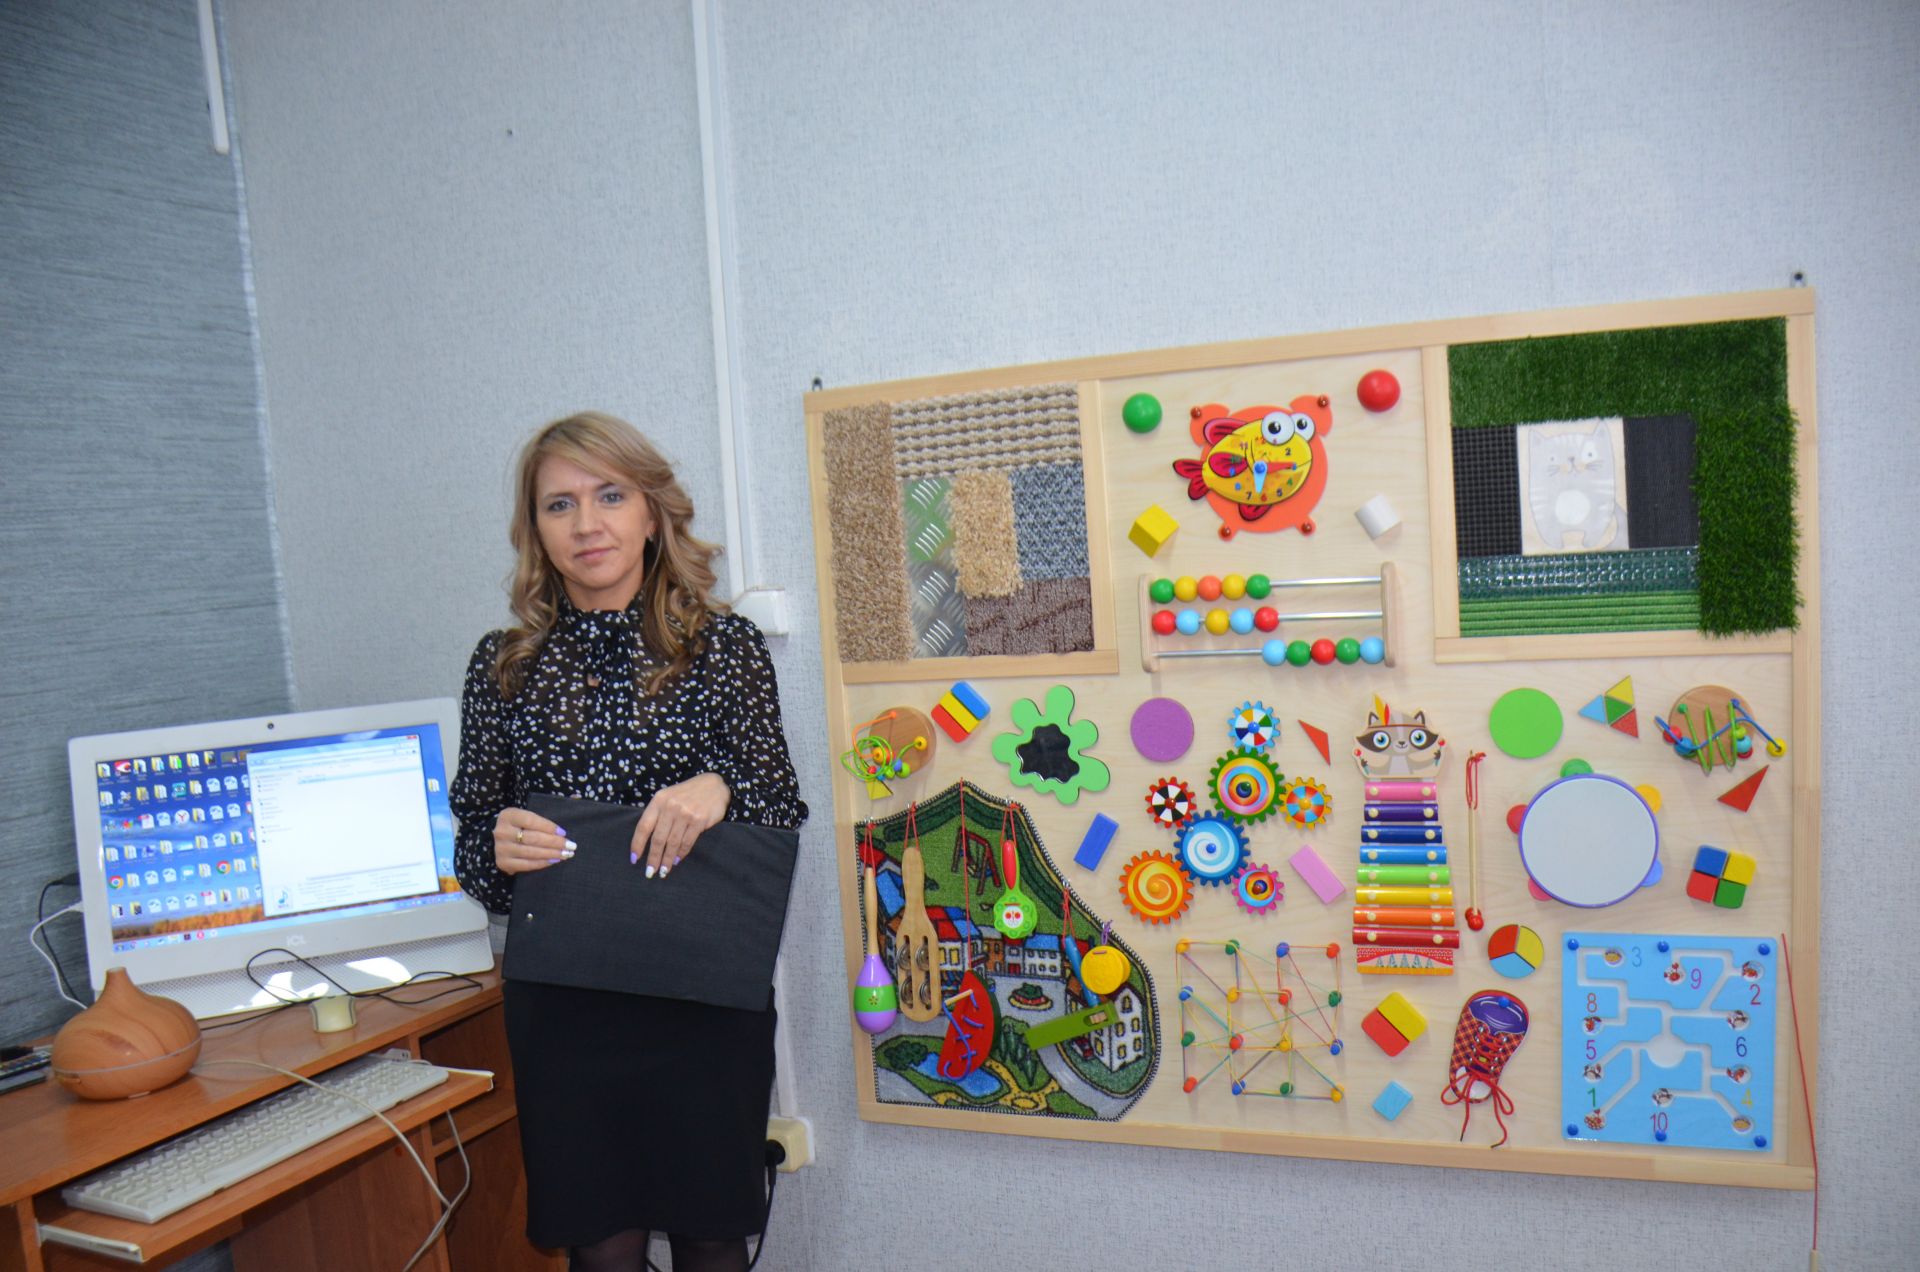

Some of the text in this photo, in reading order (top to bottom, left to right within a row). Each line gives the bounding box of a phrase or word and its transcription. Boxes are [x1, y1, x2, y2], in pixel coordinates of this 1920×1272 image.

[1631, 946, 1643, 967] 3
[1690, 968, 1702, 990] 9
[1586, 993, 1598, 1013] 8
[1751, 984, 1762, 1006] 2
[1585, 1039, 1597, 1060] 5
[1735, 1036, 1747, 1058] 6
[1587, 1087, 1596, 1107] 1
[1741, 1088, 1753, 1108] 4
[1650, 1112, 1668, 1133] 10
